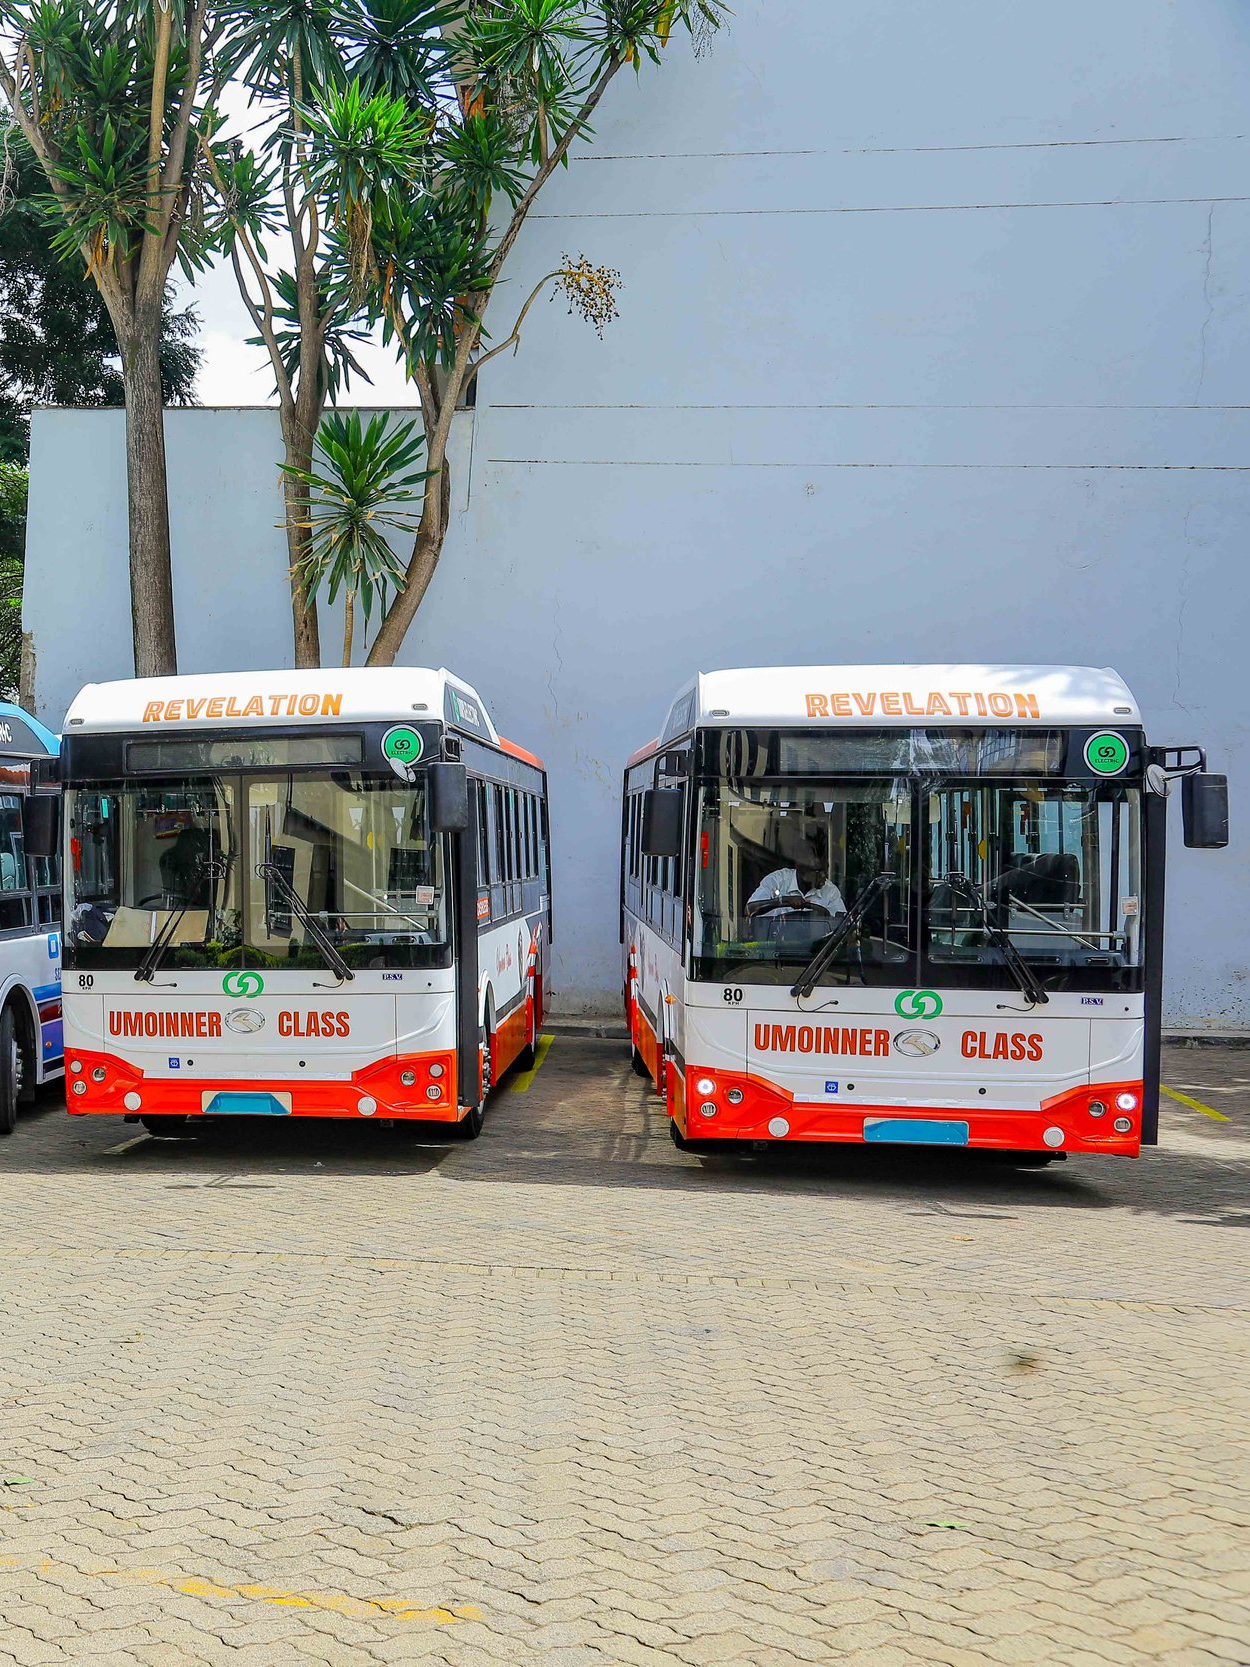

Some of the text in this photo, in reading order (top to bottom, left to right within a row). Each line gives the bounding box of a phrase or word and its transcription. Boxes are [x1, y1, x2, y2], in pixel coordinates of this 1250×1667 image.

[142, 693, 343, 722] REVELATION
[805, 691, 1040, 719] REVELATION
[78, 974, 94, 987] 80
[723, 988, 743, 1002] 80
[109, 1011, 350, 1037] UMOINNER CLASS
[754, 1023, 1044, 1062] UMOINNER CLASS
